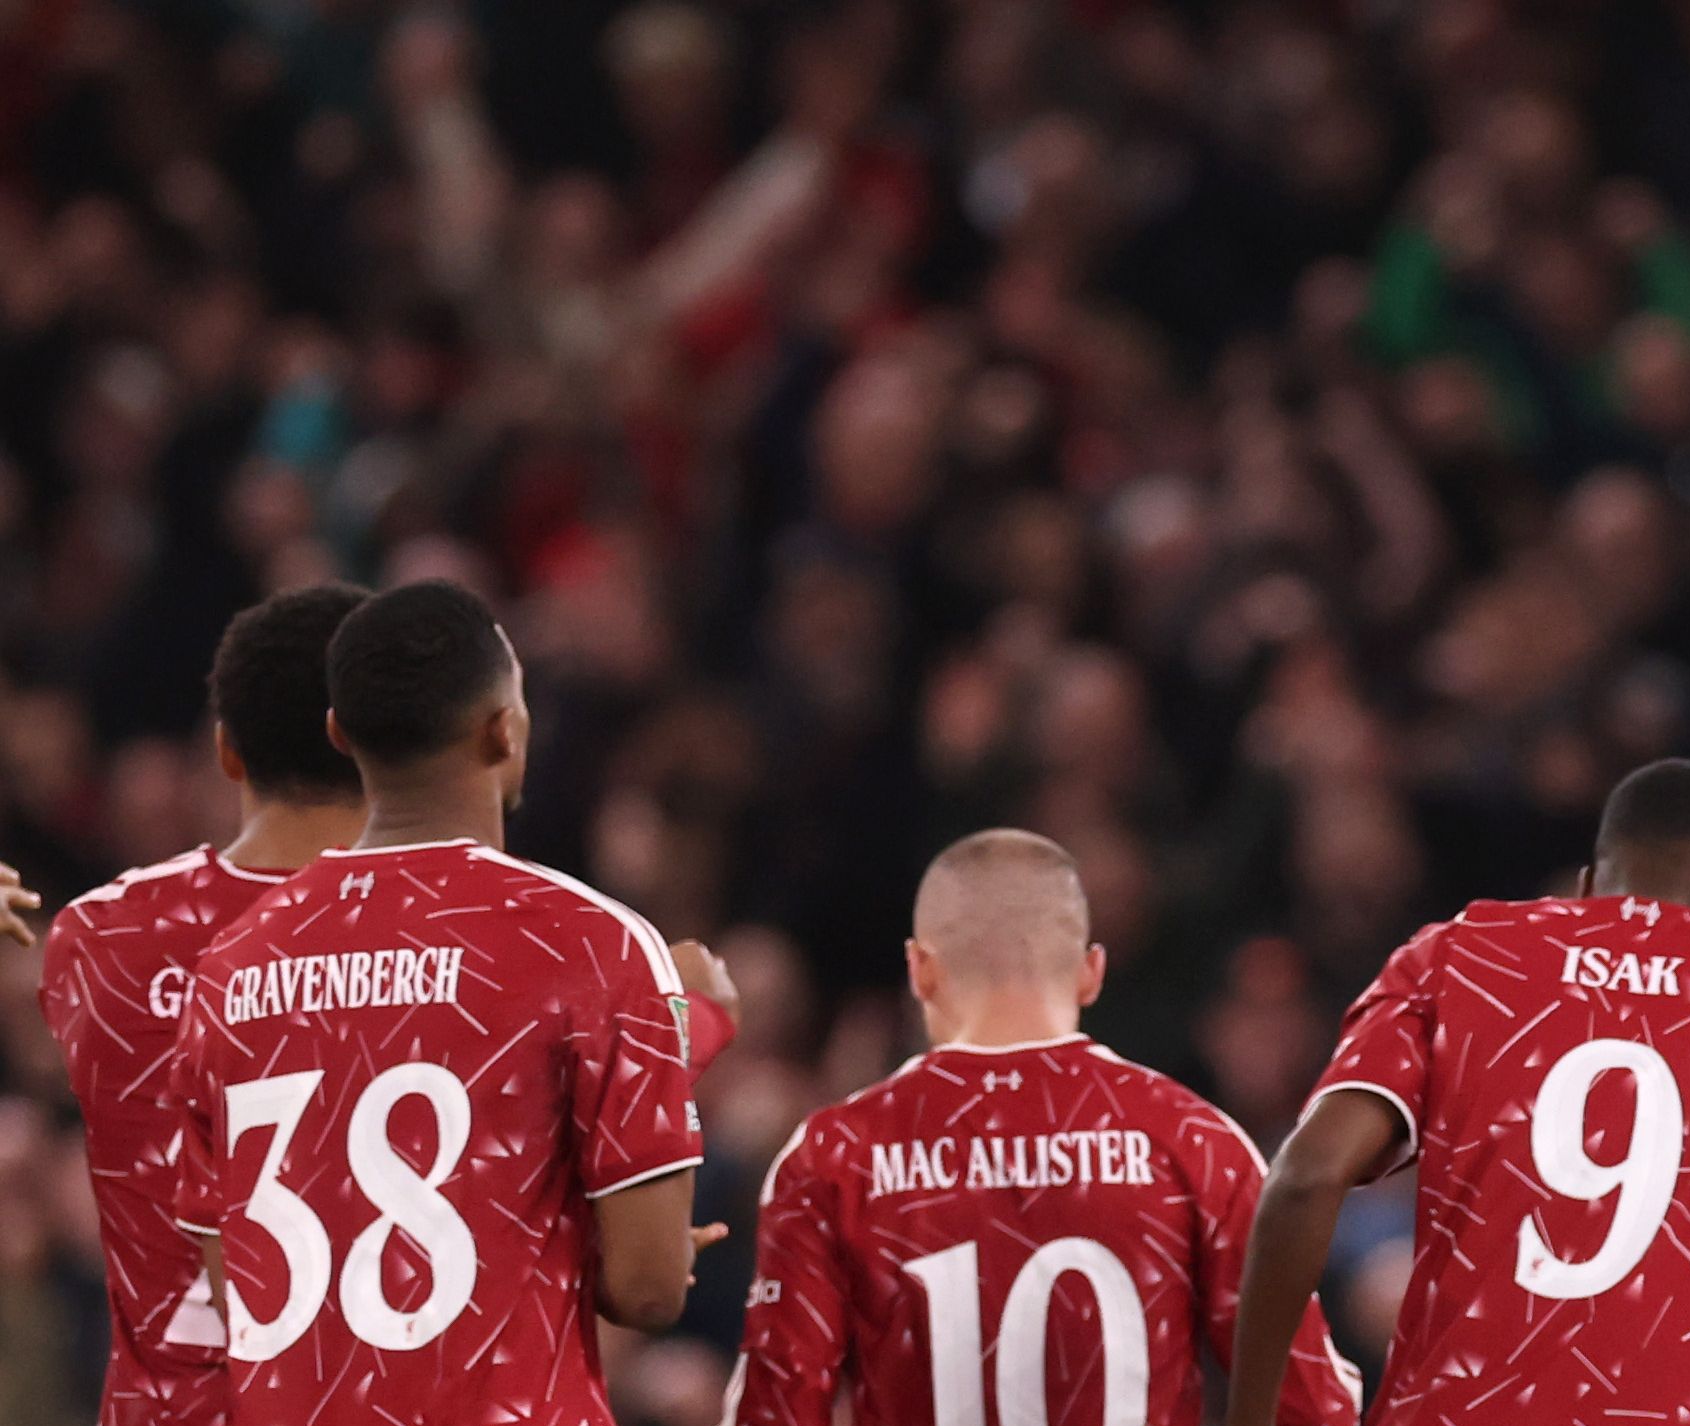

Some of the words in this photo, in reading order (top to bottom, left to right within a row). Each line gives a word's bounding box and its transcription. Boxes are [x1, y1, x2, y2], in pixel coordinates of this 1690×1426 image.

[148, 966, 196, 1019] G
[223, 946, 464, 1026] GRAVENBERCH
[1560, 945, 1685, 997] ISAK
[867, 1135, 958, 1200] MAC
[965, 1129, 1156, 1190] ALLISTER
[1514, 1037, 1684, 1300] 9
[223, 1061, 478, 1362] 38
